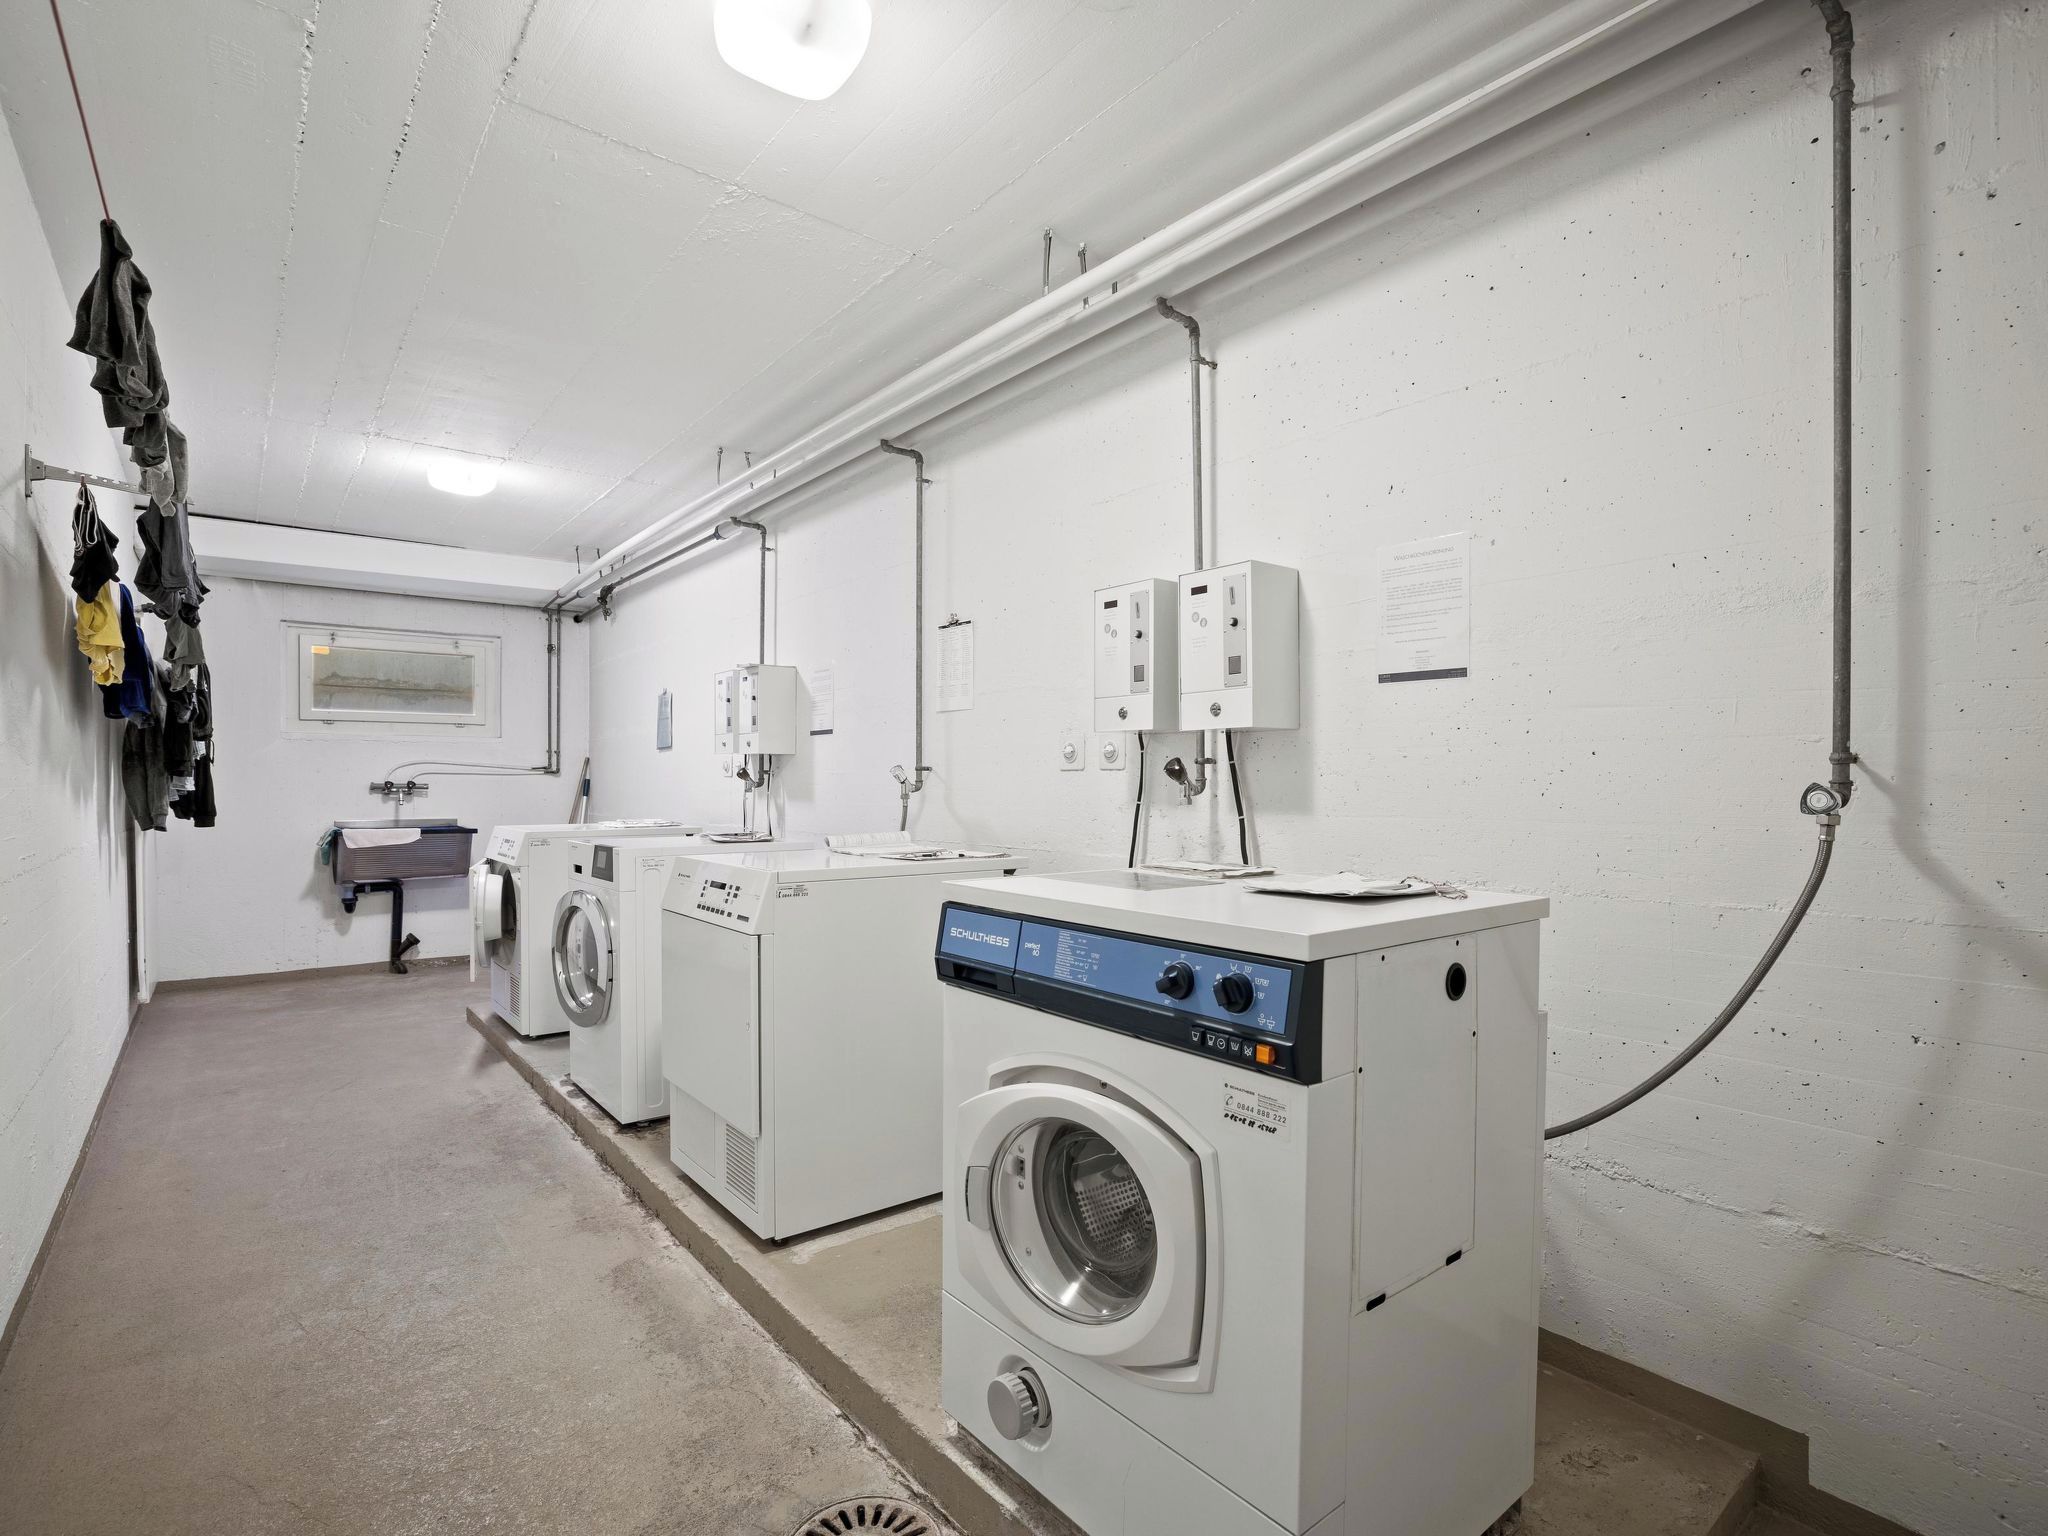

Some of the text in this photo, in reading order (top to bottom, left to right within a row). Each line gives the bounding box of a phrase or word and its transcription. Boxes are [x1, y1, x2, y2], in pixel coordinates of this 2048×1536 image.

[950, 927, 1010, 948] SCHULTHESS
[1236, 1102, 1254, 1114] 0844
[1256, 1108, 1271, 1119] 888
[1273, 1113, 1287, 1124] 222
